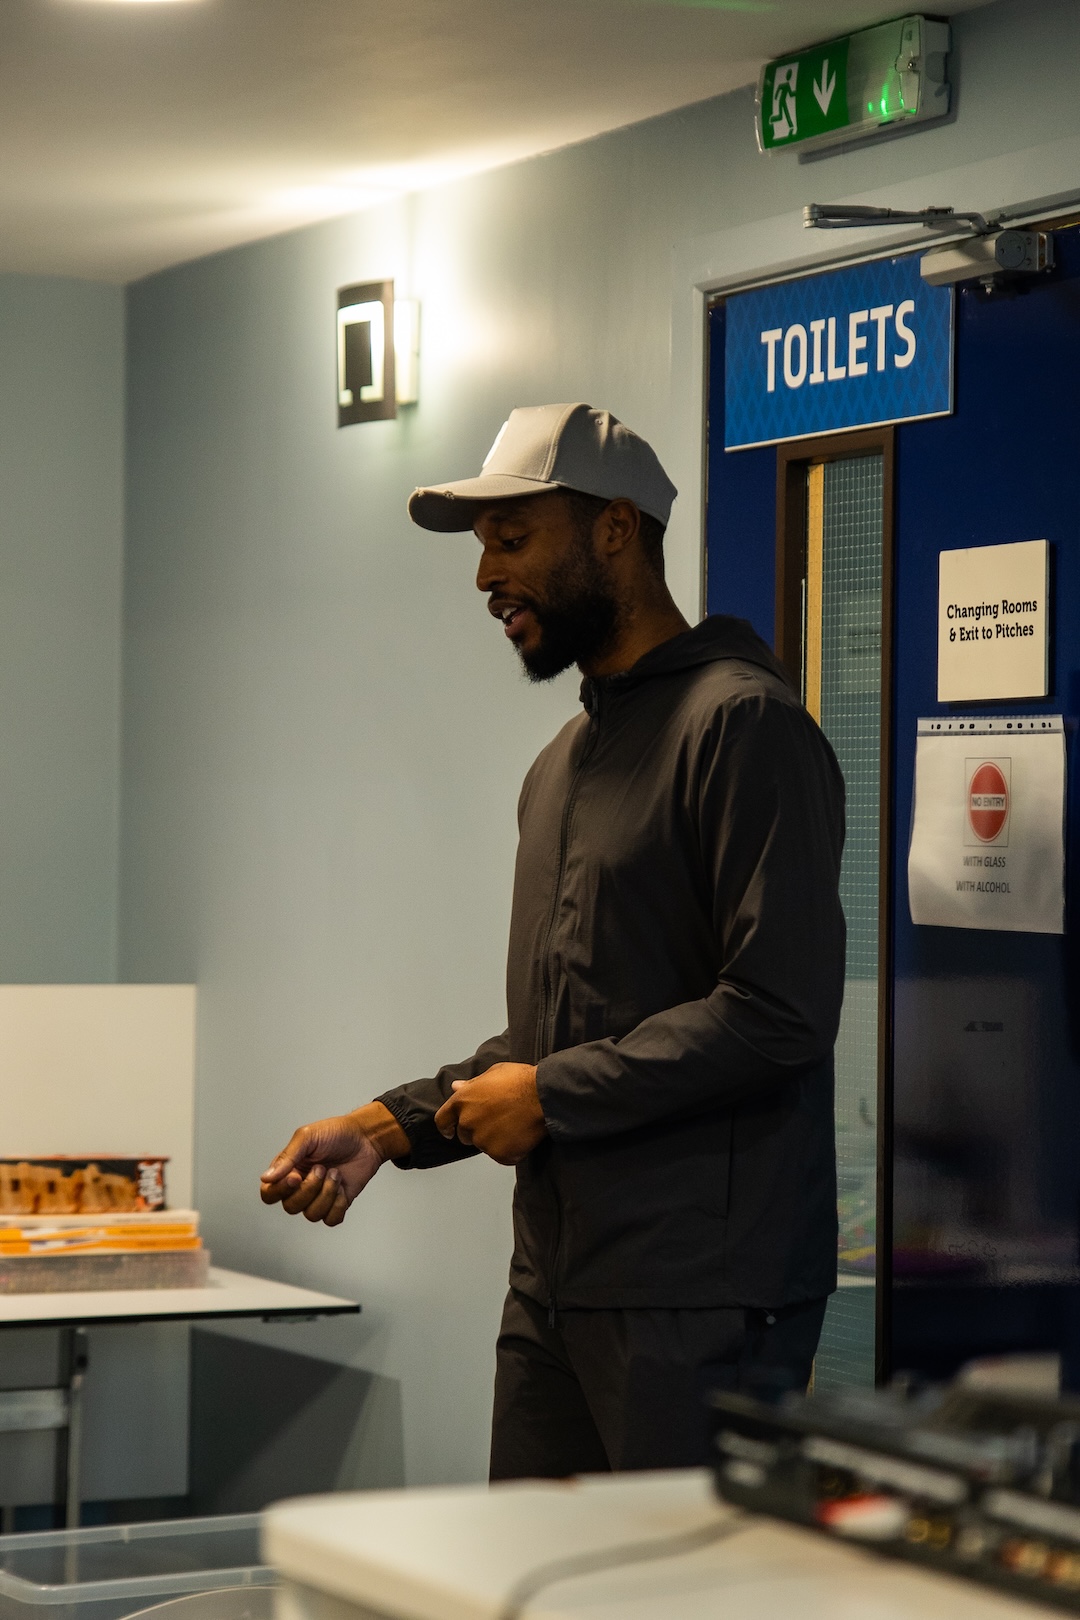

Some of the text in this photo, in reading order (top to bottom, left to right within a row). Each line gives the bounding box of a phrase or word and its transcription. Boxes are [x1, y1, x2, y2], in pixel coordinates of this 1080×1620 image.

[761, 300, 917, 392] TOILETS
[947, 599, 1038, 620] Changing Rooms
[949, 622, 1034, 642] & Exit to Pitches
[972, 797, 1005, 807] NO ENTRY
[963, 856, 1006, 868] WITH GLASS
[956, 880, 1011, 893] WITH ALCOHOL
